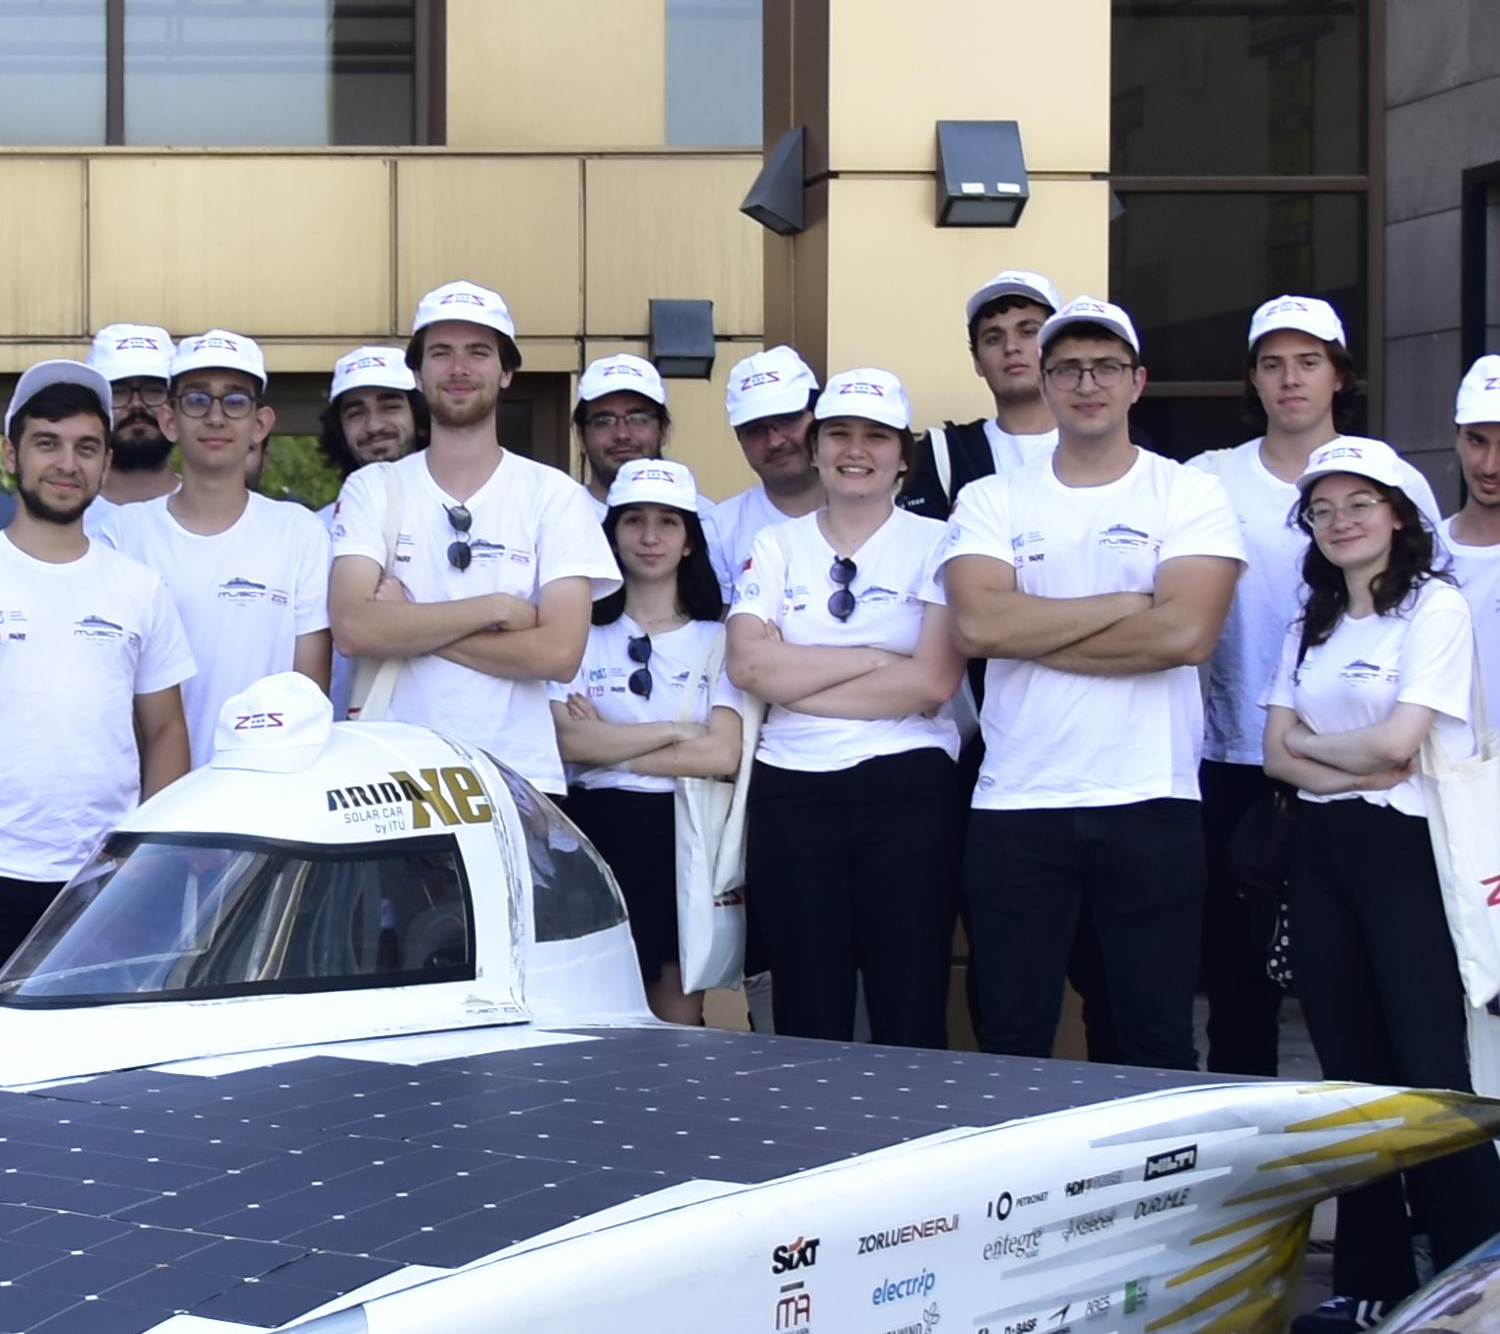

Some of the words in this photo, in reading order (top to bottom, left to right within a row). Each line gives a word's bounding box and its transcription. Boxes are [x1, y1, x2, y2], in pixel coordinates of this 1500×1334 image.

[235, 713, 284, 730] ZES
[344, 809, 379, 823] SOLAR
[382, 806, 404, 818] CAR
[375, 824, 387, 834] by
[872, 1268, 936, 1306] electrip
